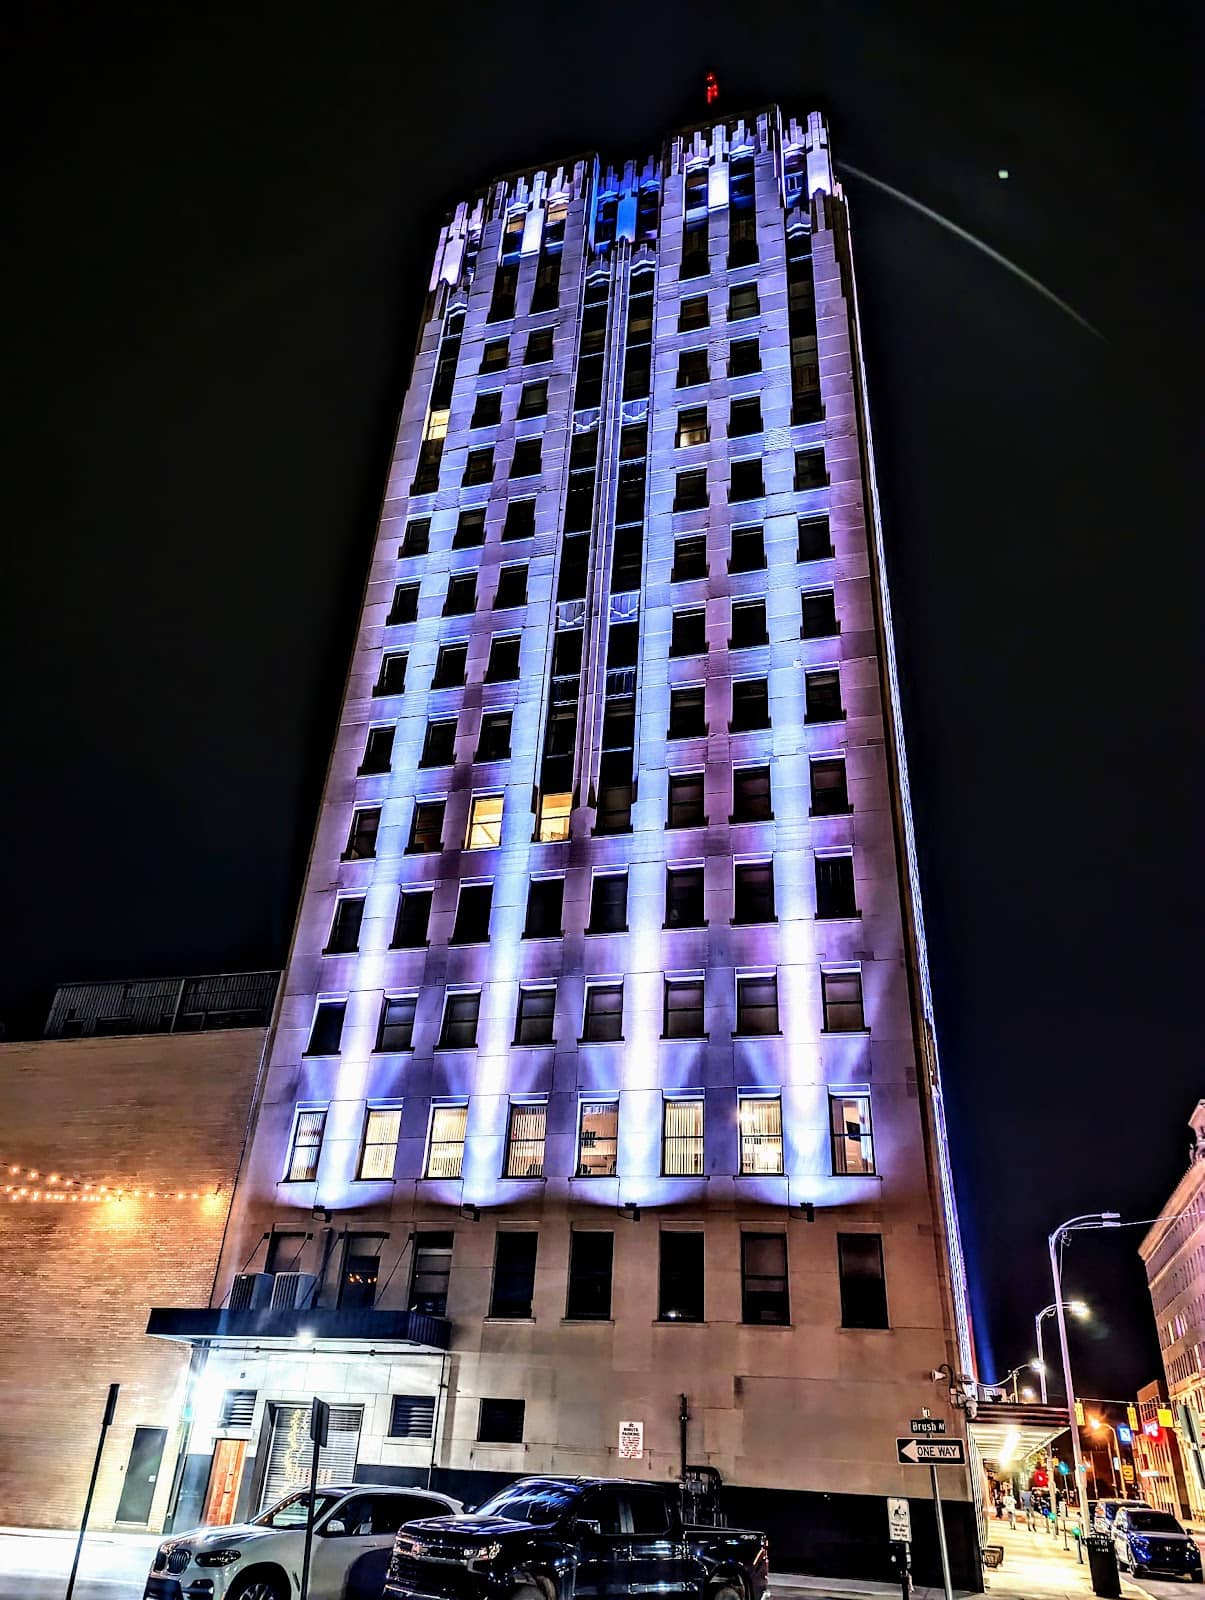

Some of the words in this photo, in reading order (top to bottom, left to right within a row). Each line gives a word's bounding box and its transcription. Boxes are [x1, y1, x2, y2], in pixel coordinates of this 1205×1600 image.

[912, 1421, 937, 1431] Brush
[917, 1446, 935, 1457] ONE
[937, 1446, 957, 1457] WAY
